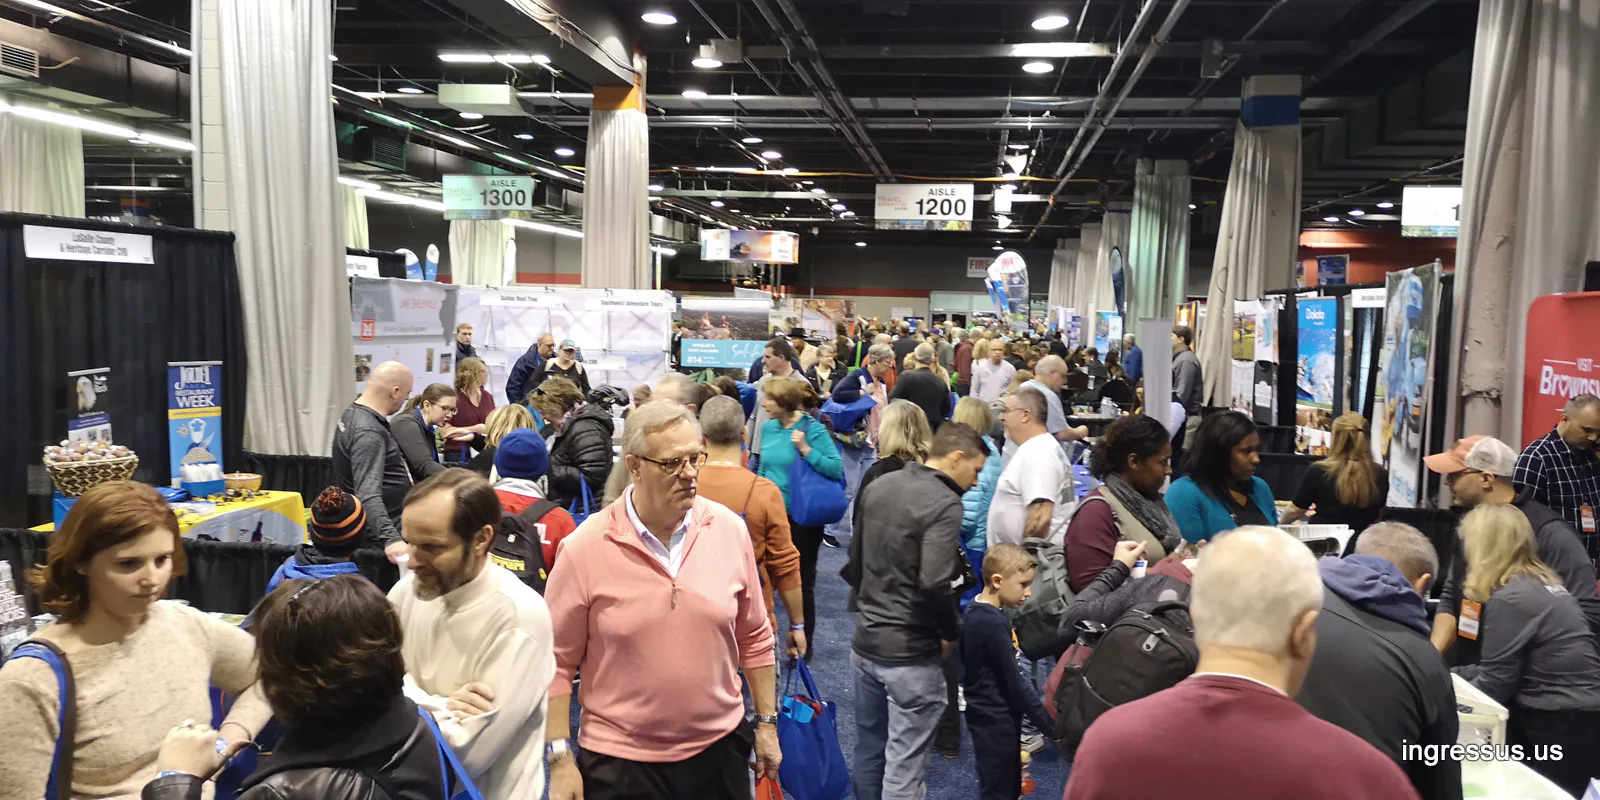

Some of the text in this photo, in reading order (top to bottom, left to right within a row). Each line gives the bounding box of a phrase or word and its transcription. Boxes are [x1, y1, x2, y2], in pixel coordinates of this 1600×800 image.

[491, 179, 517, 187] AISLE
[480, 189, 526, 206] 1300
[928, 188, 956, 196] AISLE
[916, 198, 966, 216] 1200
[686, 356, 703, 364] #14
[1577, 358, 1593, 372] VISIT
[176, 395, 215, 408] WEEK
